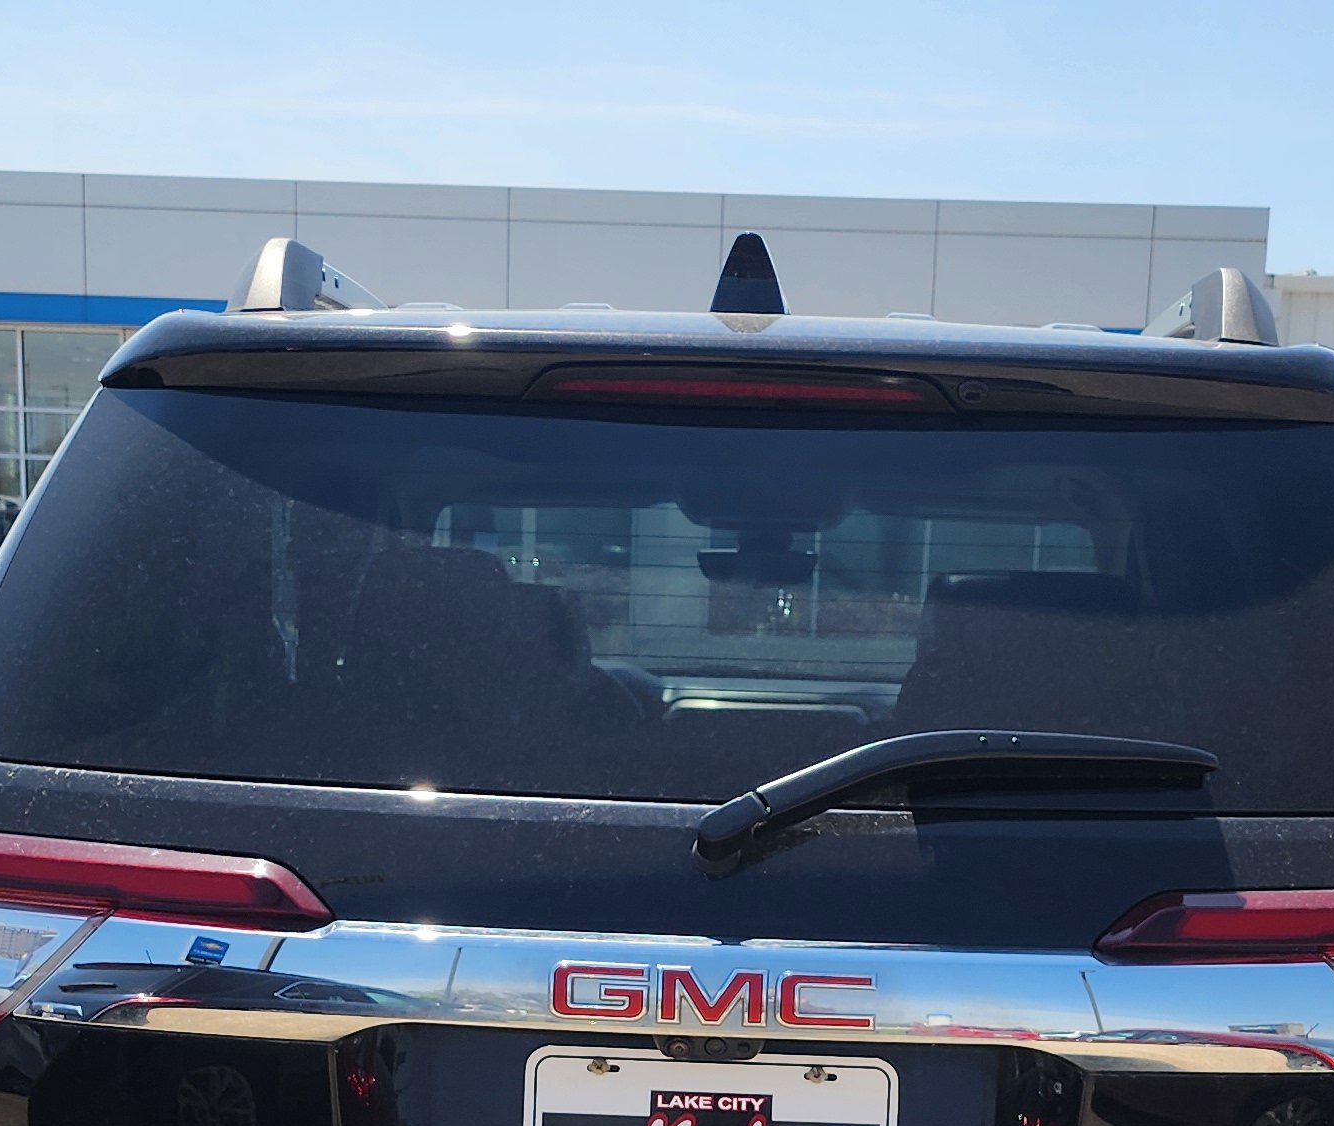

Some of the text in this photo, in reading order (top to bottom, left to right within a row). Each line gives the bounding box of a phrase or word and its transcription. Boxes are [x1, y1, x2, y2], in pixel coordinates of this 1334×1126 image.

[549, 960, 876, 1031] GMC
[657, 1094, 766, 1111] LAKE CITY
